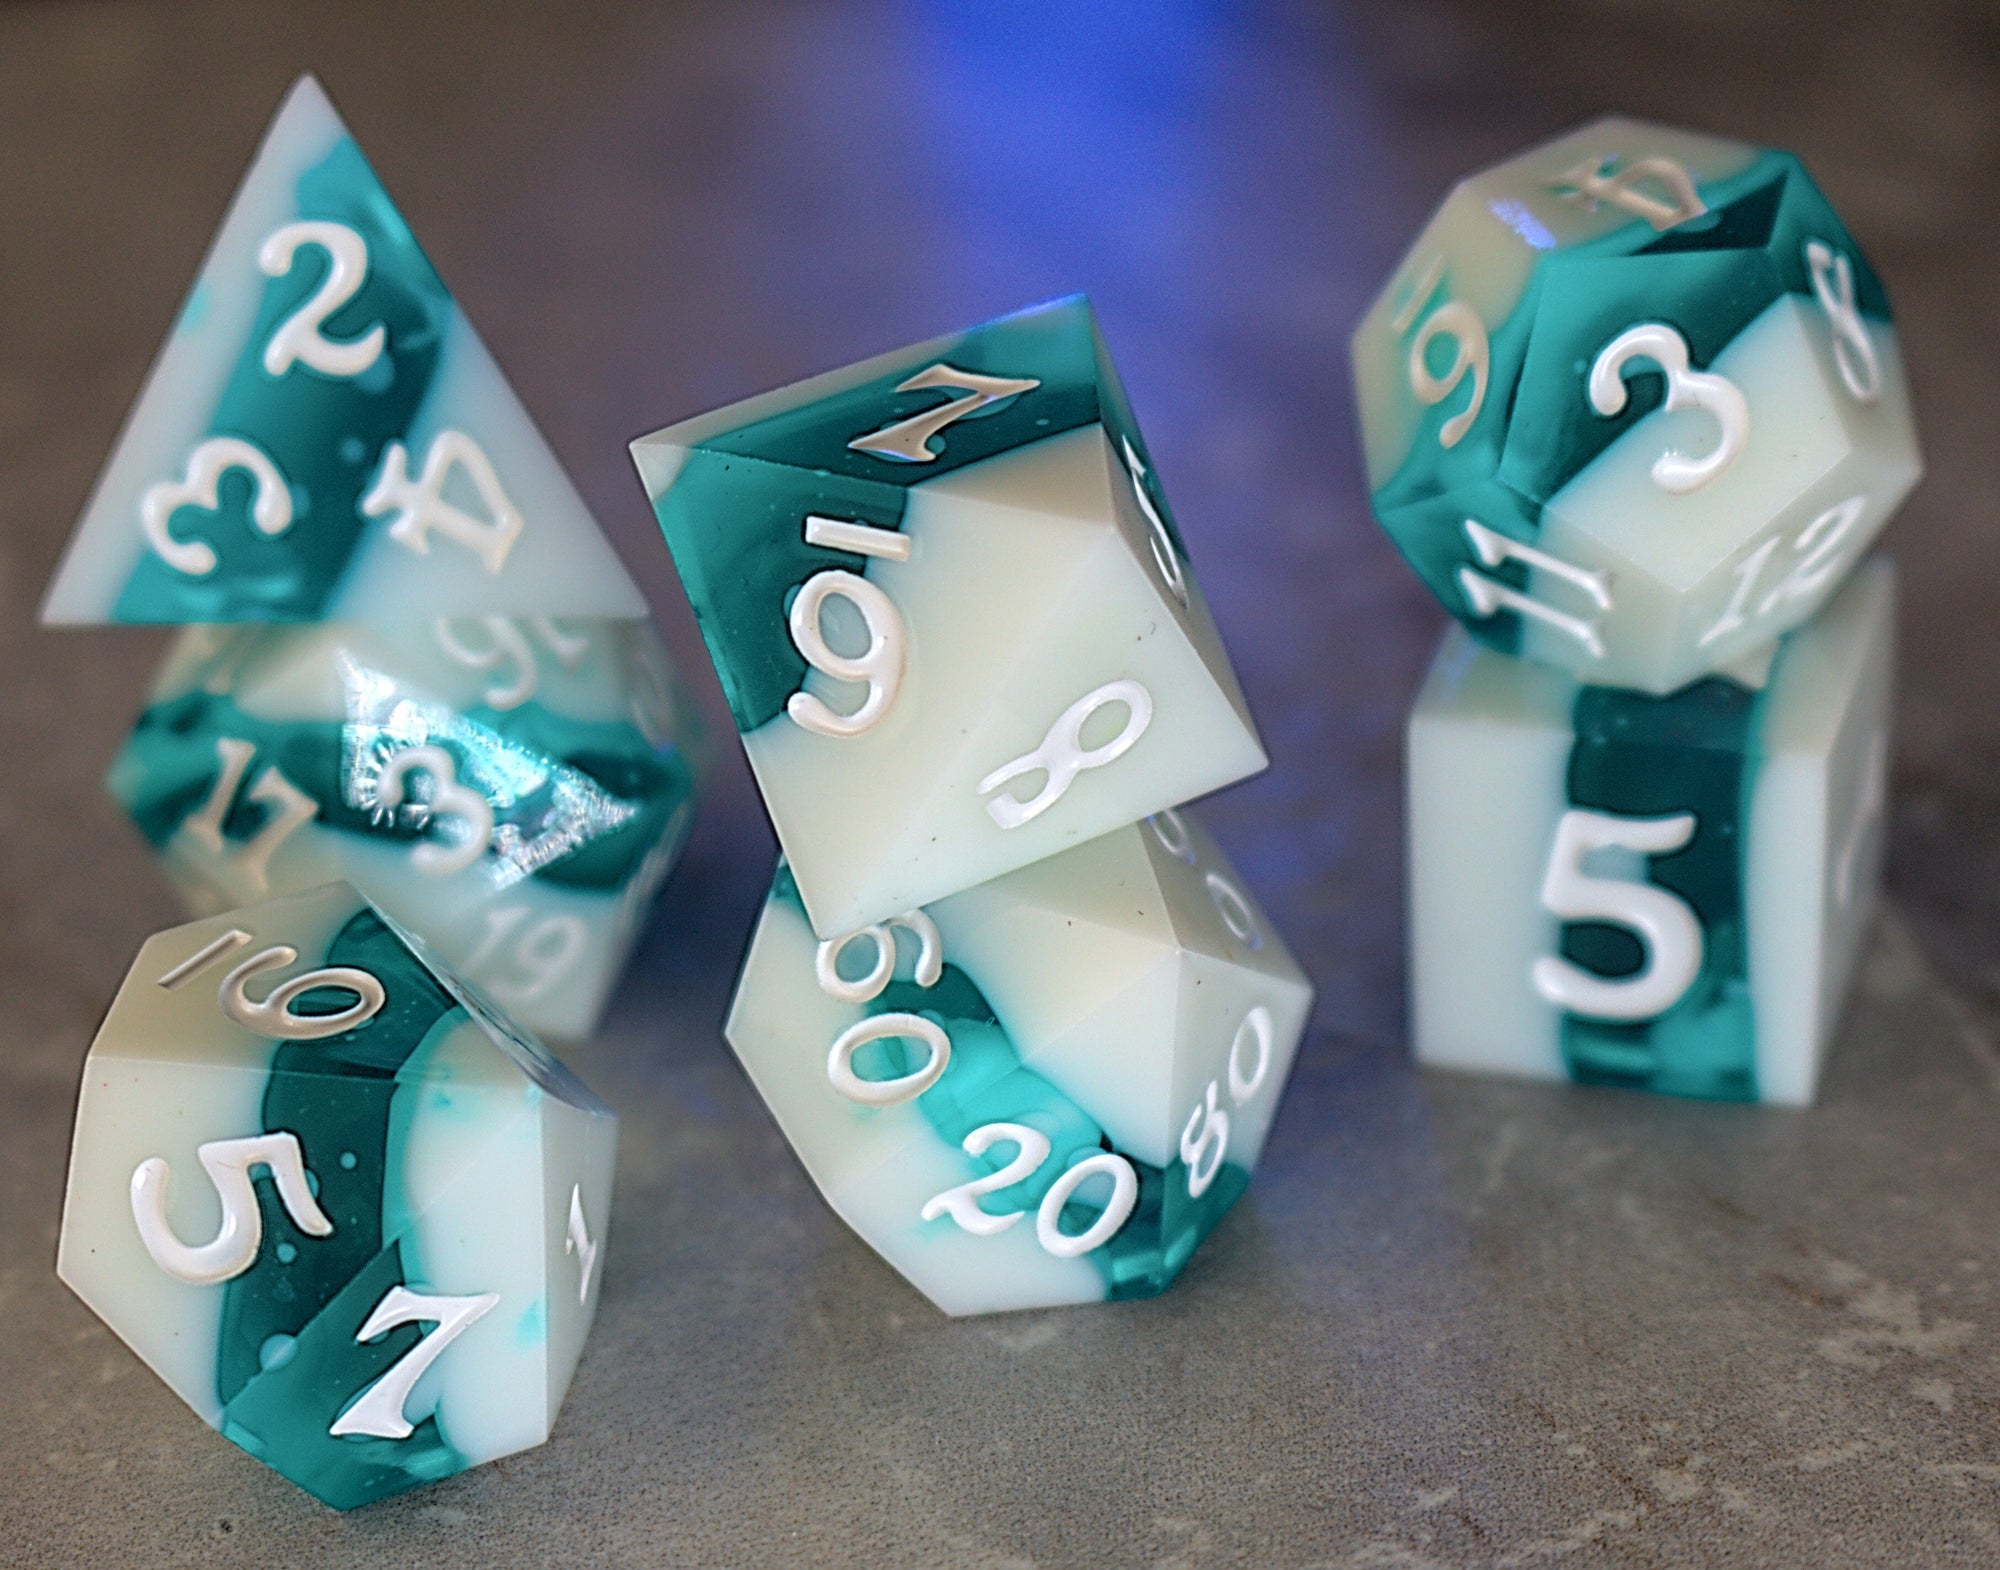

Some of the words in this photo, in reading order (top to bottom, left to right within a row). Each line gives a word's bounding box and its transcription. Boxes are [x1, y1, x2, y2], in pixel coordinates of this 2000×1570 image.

[258, 220, 385, 376] 2
[1806, 241, 1881, 403] 8
[847, 363, 1042, 462] 7
[1588, 322, 1749, 496] 3
[140, 437, 294, 576] 3
[362, 430, 524, 574] 4
[1698, 495, 1867, 647] 12
[1460, 518, 1615, 658] 11
[377, 744, 495, 876] 3
[976, 679, 1153, 830] 8
[461, 905, 590, 1000] 19
[1531, 810, 1706, 1020] 5
[130, 1132, 333, 1285] 5
[565, 1183, 598, 1307] 1
[921, 1122, 1139, 1258] 20
[329, 1285, 500, 1438] 7
